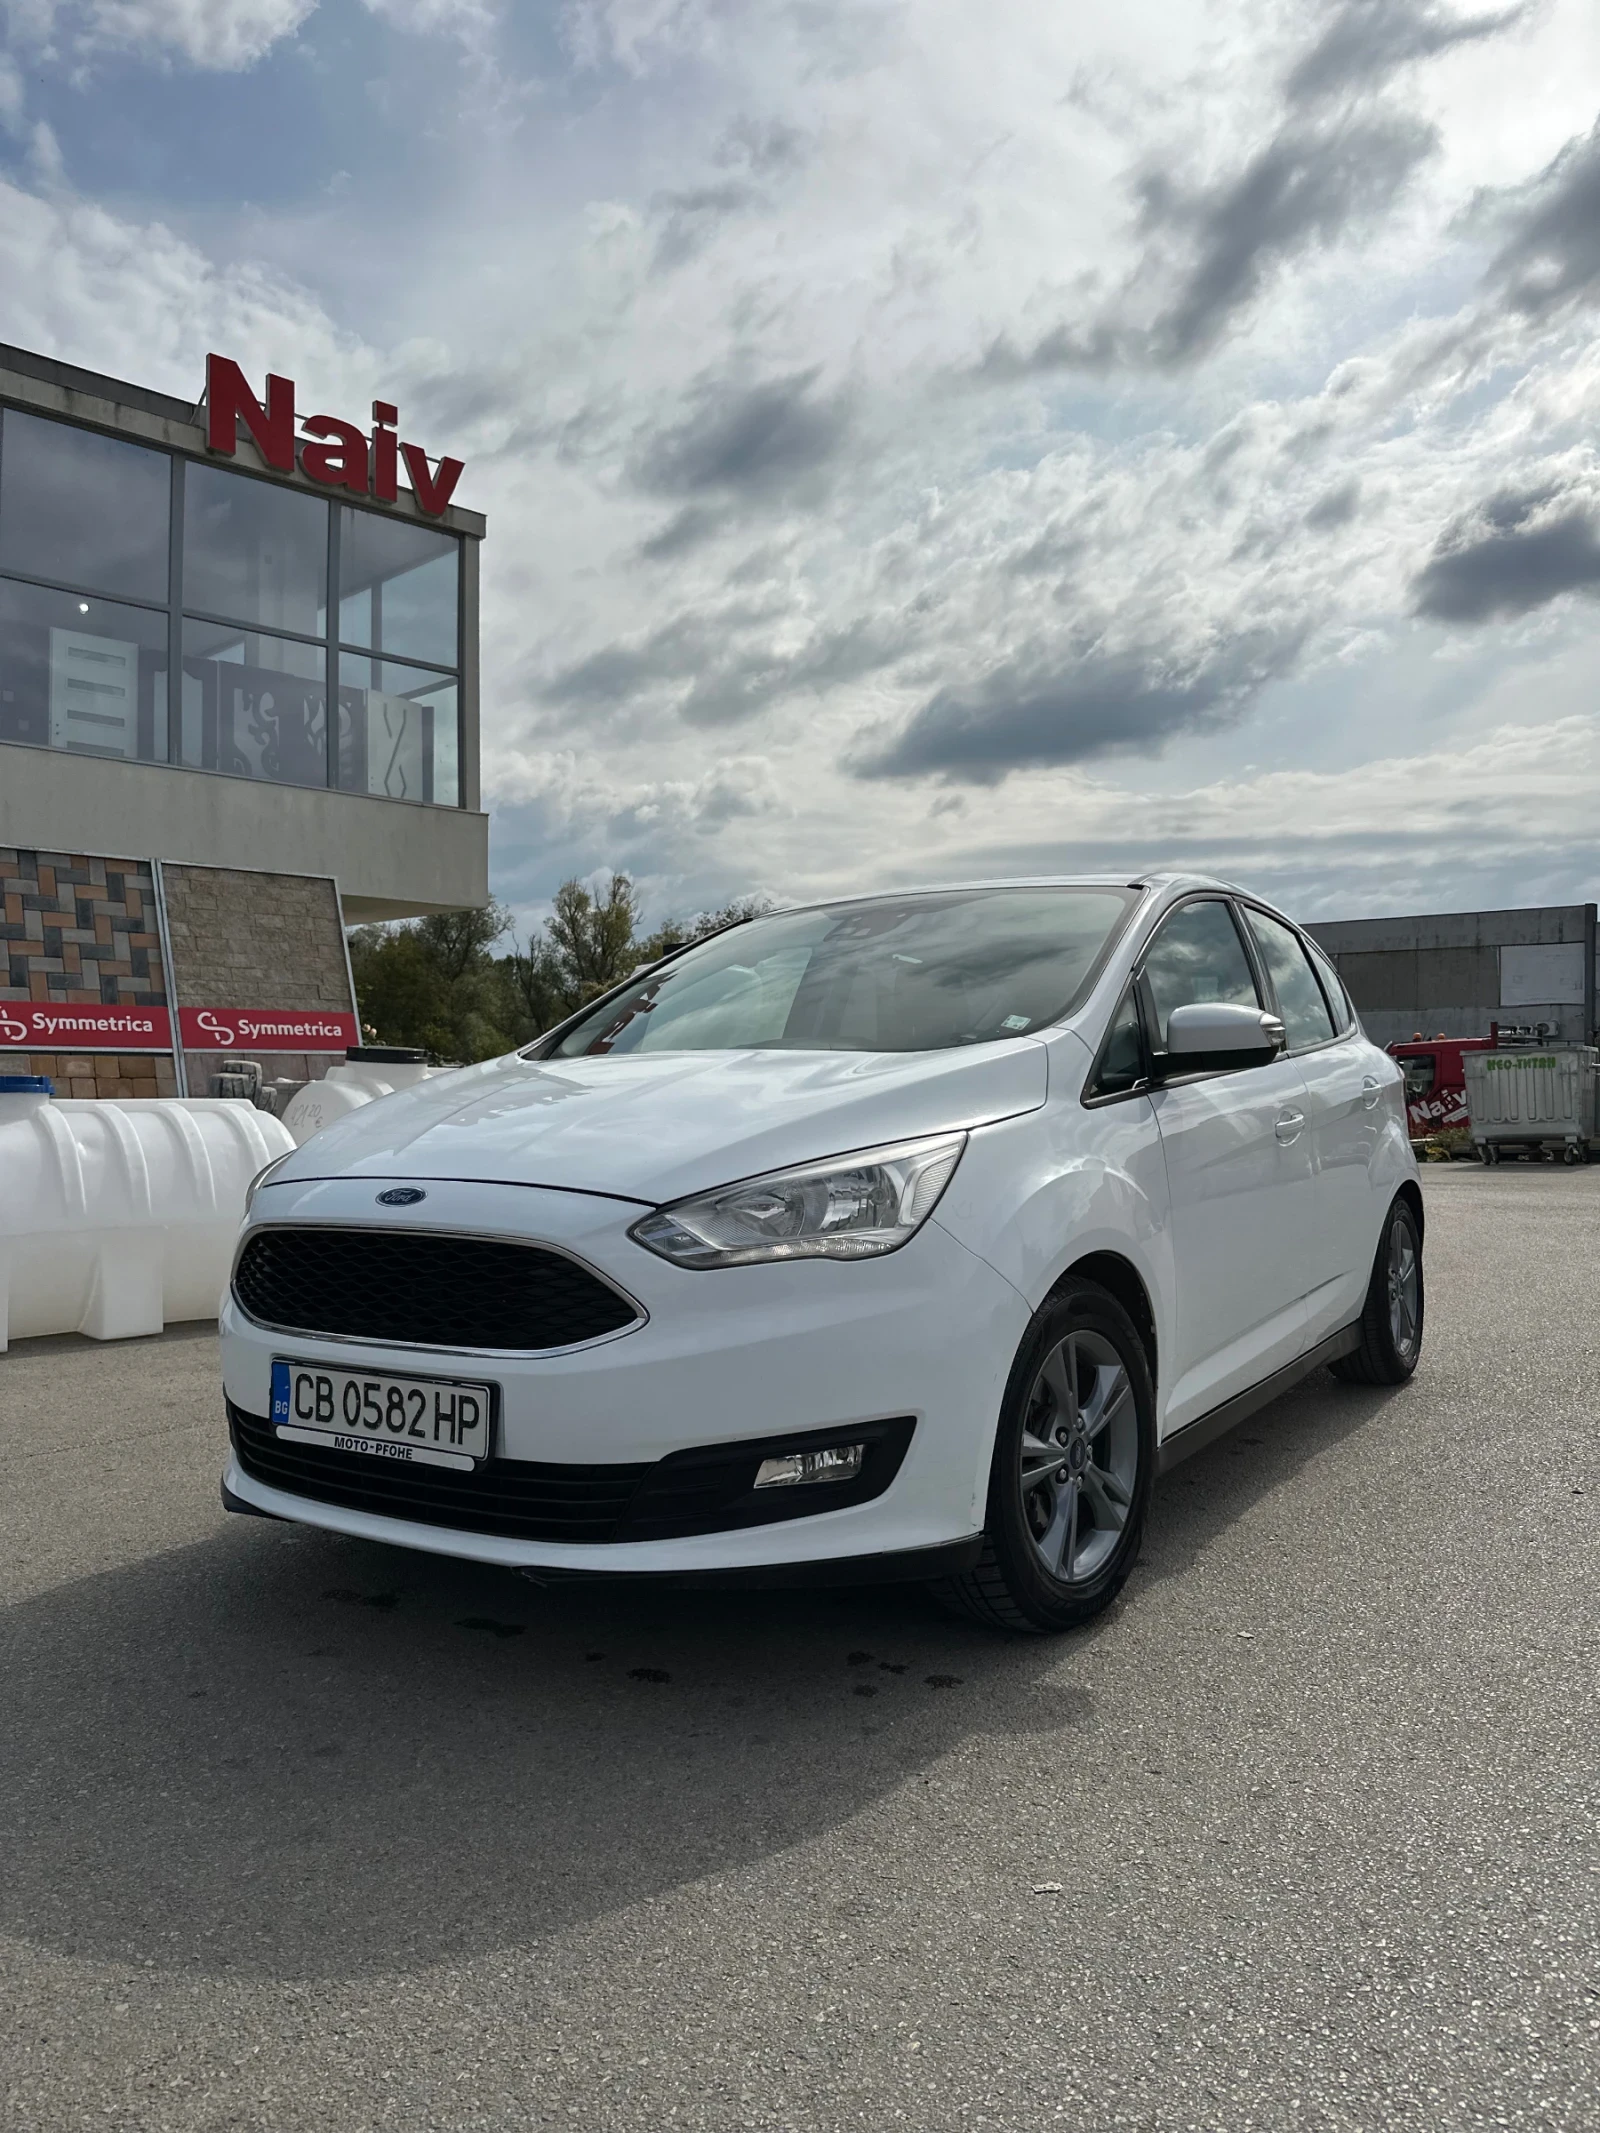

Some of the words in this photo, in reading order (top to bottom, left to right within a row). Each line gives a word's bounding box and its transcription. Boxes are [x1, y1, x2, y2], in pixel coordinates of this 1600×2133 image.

[206, 352, 466, 518] Naiv
[32, 1012, 153, 1034] Symmetrica
[238, 1018, 342, 1039] Symmetrica
[385, 1190, 416, 1202] Ford
[275, 1400, 288, 1414] BG
[294, 1373, 335, 1423] CB
[342, 1379, 427, 1438] 0582
[433, 1391, 480, 1445] HP
[334, 1436, 413, 1460] MOTO-PFOHE
